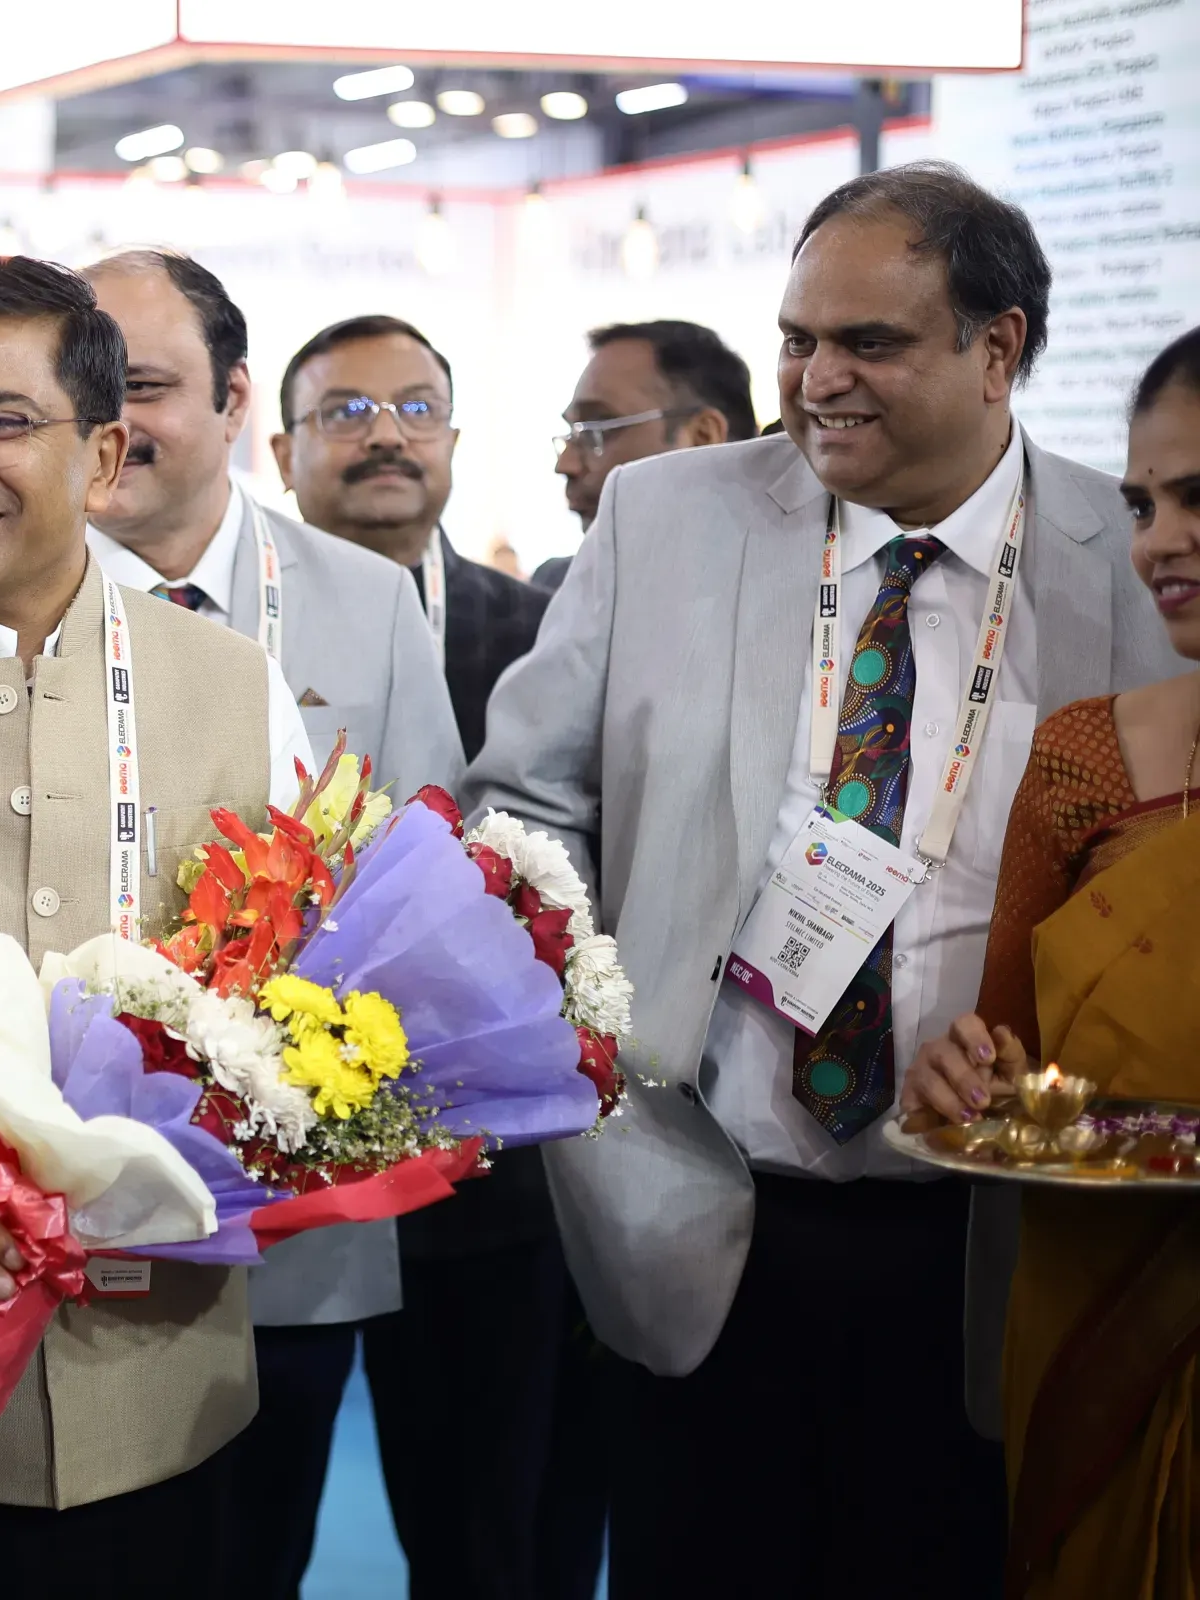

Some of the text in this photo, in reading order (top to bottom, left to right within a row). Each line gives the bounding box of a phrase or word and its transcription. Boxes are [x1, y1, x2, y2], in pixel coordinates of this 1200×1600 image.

[823, 549, 831, 578] ieema
[993, 581, 1005, 613] ELECRAMA
[983, 630, 996, 660] ieema
[820, 677, 828, 707] ieema
[961, 709, 976, 744] ELECRAMA
[119, 763, 128, 794] ieema
[944, 761, 960, 792] ieema
[826, 856, 866, 886] ELECRAMA
[865, 880, 886, 897] 2025
[885, 865, 909, 883] ieema
[785, 920, 824, 949] STELMEC LIMITED
[788, 908, 805, 924] NIKHIL
[805, 919, 835, 942] SHANBAGH
[730, 962, 753, 984] NEC/OC
